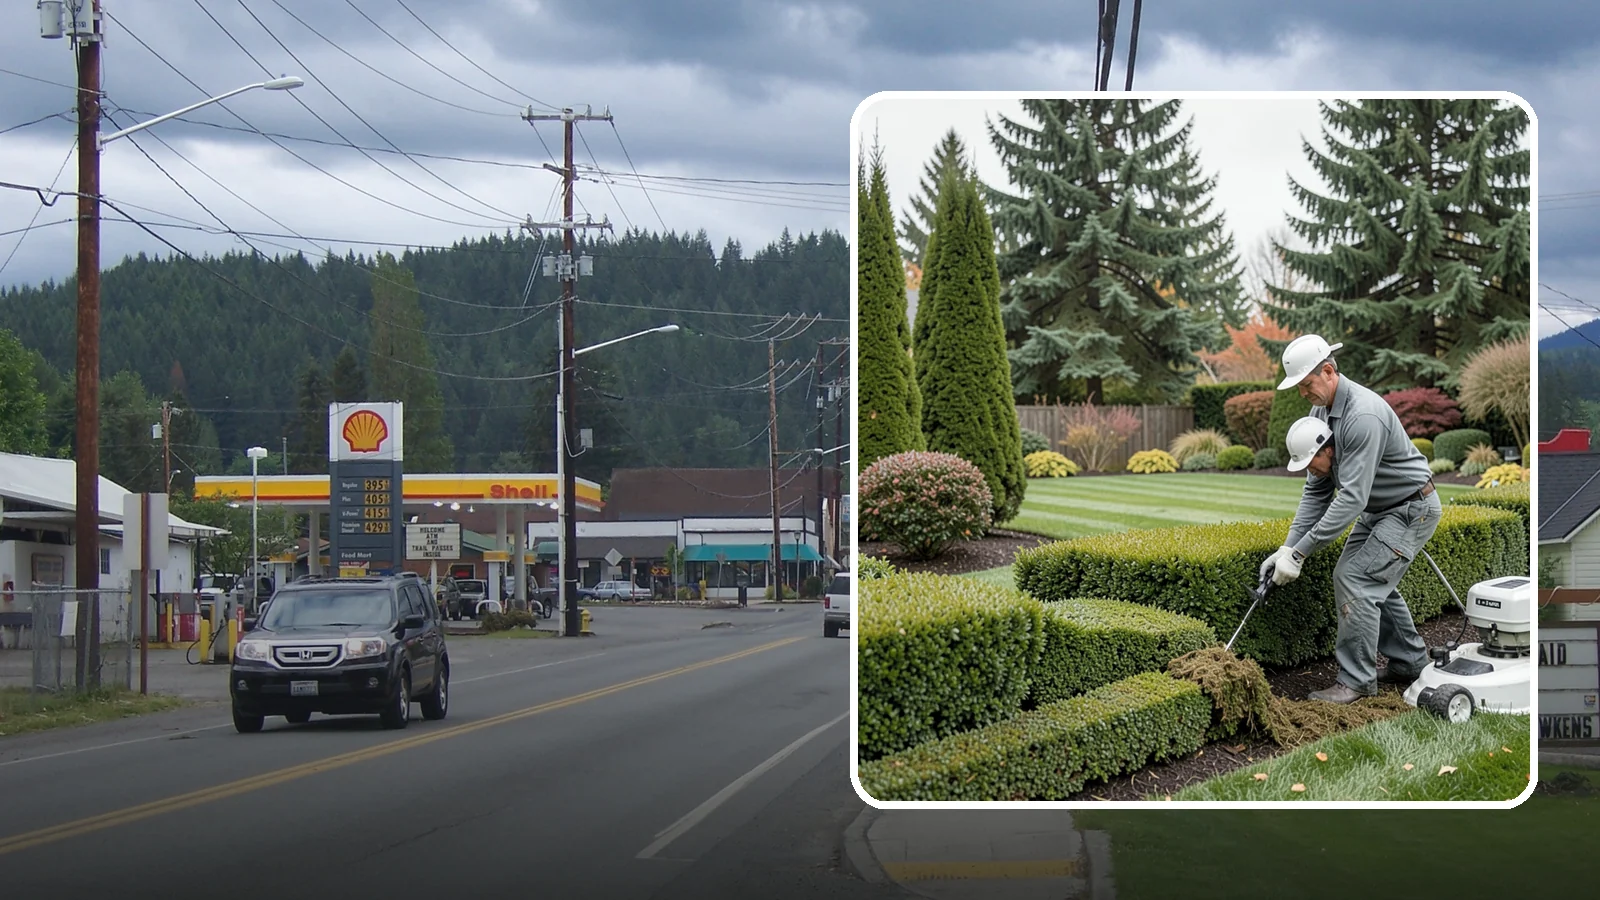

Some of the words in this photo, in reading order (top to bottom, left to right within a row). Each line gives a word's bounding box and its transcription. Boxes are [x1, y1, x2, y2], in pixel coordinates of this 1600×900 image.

[366, 480, 383, 490] 395
[490, 484, 547, 499] Shell
[366, 494, 383, 504] 405
[366, 508, 383, 518] 415
[366, 522, 383, 533] 429
